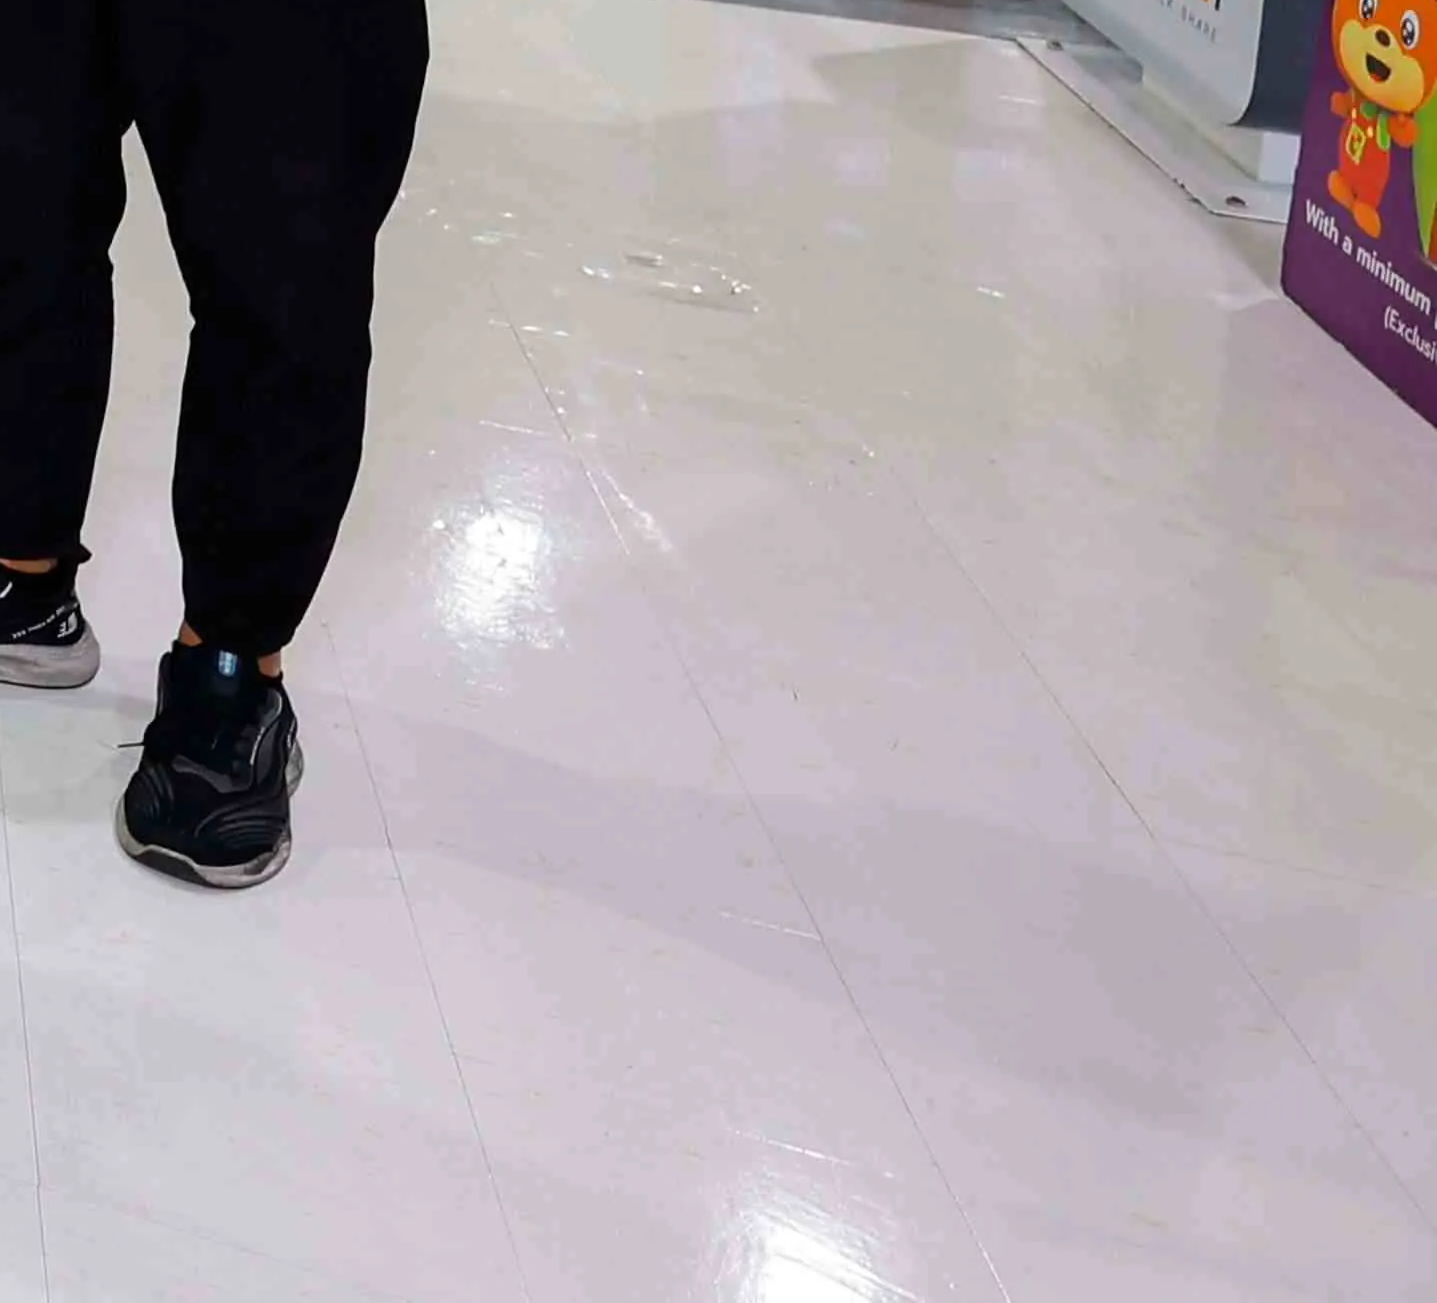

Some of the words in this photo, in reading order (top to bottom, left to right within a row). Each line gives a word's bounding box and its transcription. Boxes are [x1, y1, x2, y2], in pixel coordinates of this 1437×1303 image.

[1305, 199, 1339, 245] With
[1342, 236, 1353, 256] a
[1356, 251, 1432, 315] minimum
